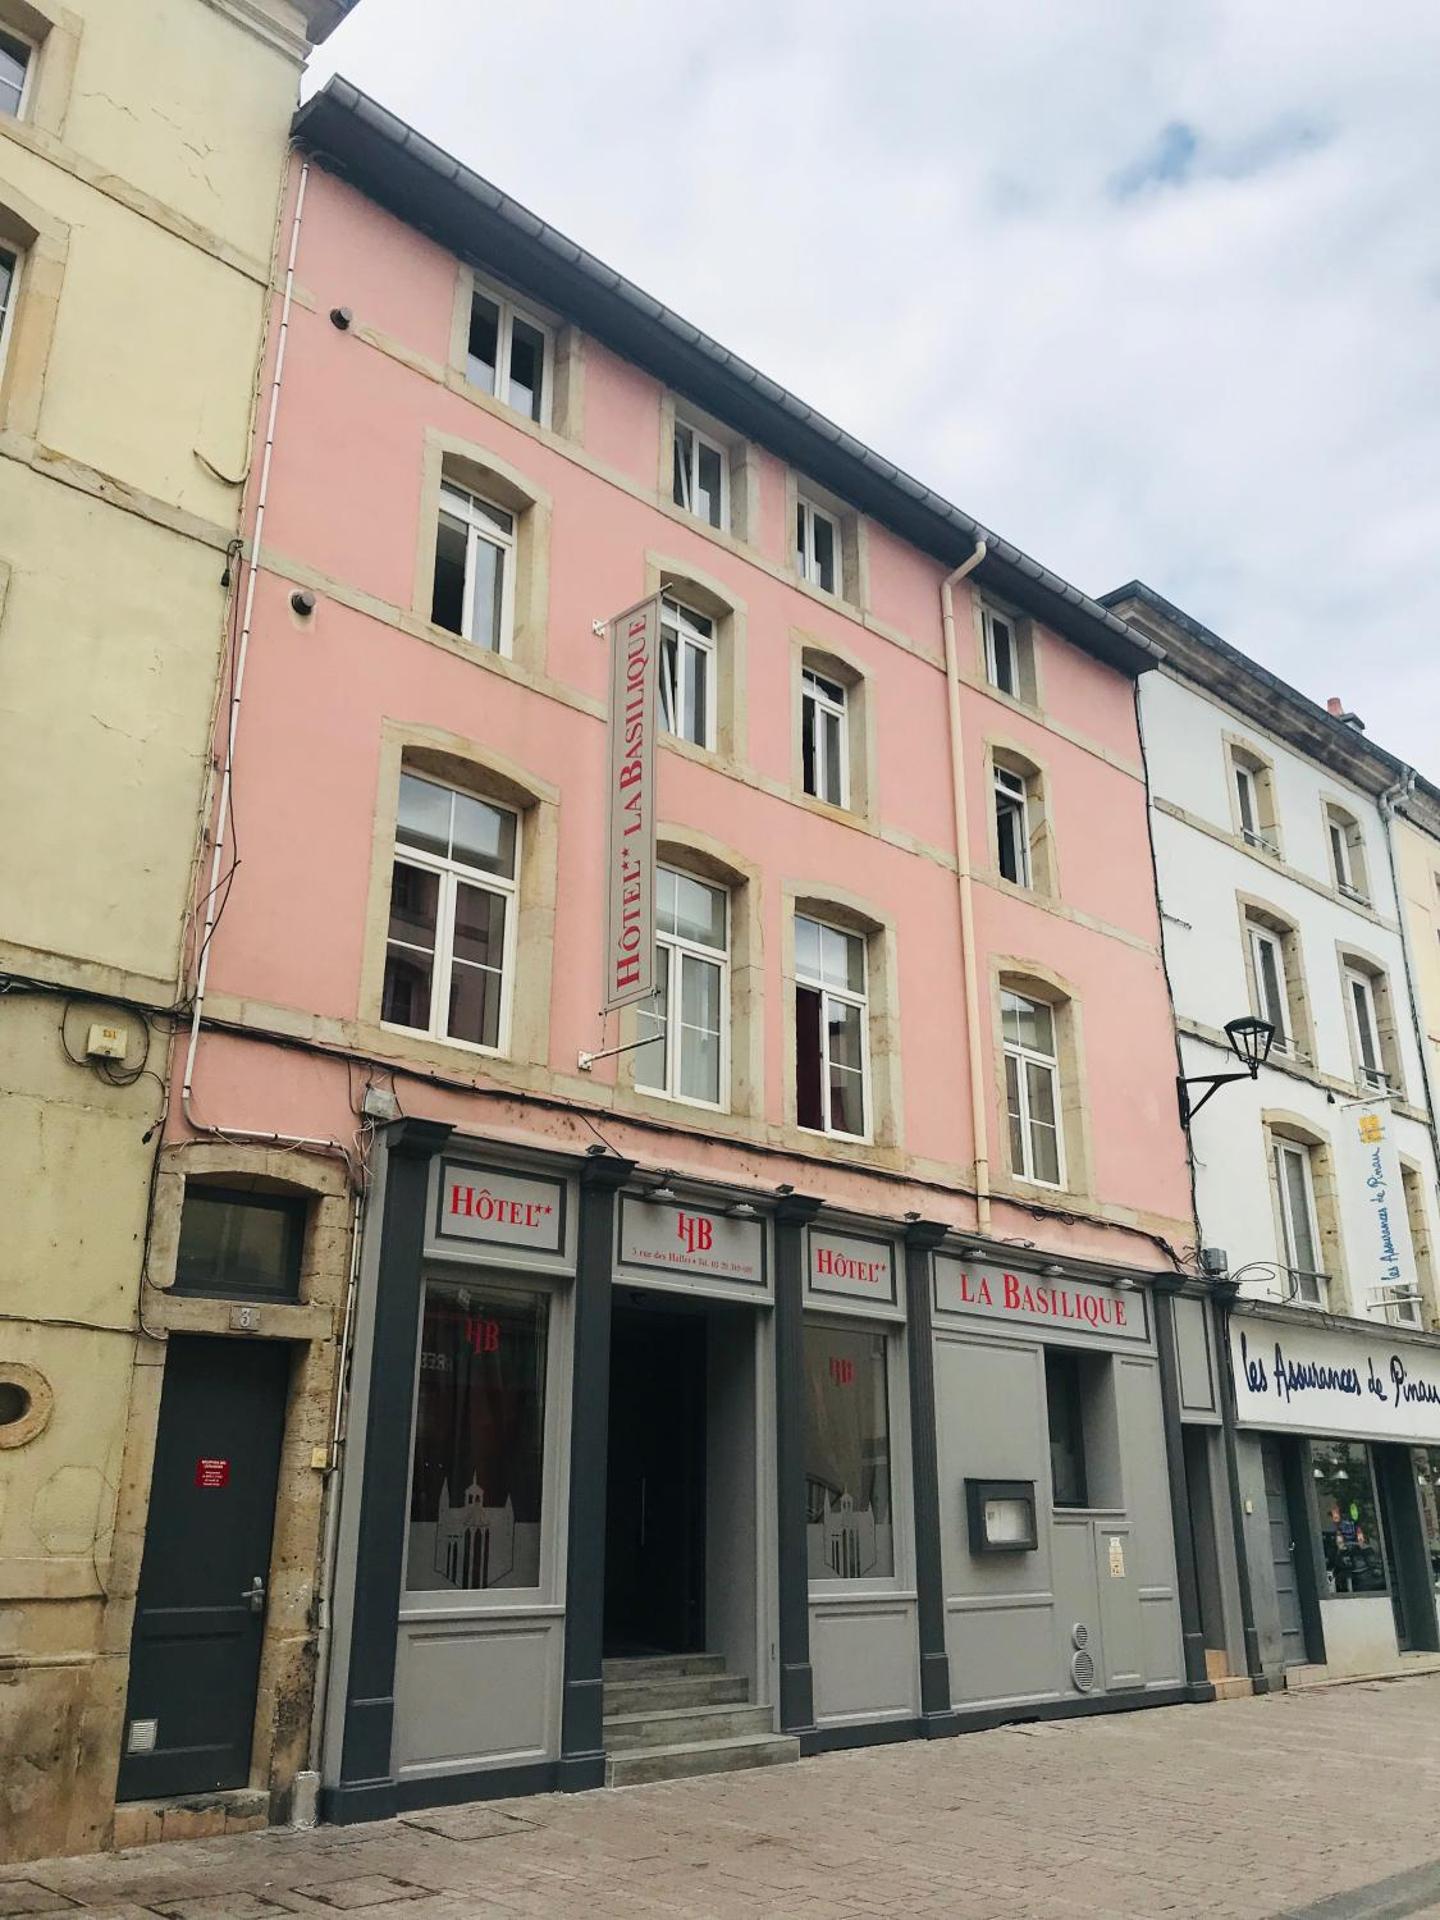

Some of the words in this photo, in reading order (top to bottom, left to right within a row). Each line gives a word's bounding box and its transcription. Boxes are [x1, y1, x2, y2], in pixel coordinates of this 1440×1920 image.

[619, 613, 649, 790] BASILIQUE
[623, 791, 642, 837] LA
[615, 859, 642, 992] HÔTEL
[450, 1183, 540, 1228] HÔTEL
[1370, 1189, 1386, 1203] de
[639, 1250, 652, 1258] rue
[653, 1250, 666, 1260] des
[816, 1249, 879, 1283] HÔTEL
[960, 1273, 993, 1305] LA
[1004, 1272, 1128, 1327] BASILIQUE
[1273, 1343, 1362, 1403] Assurances
[1367, 1357, 1388, 1401] de
